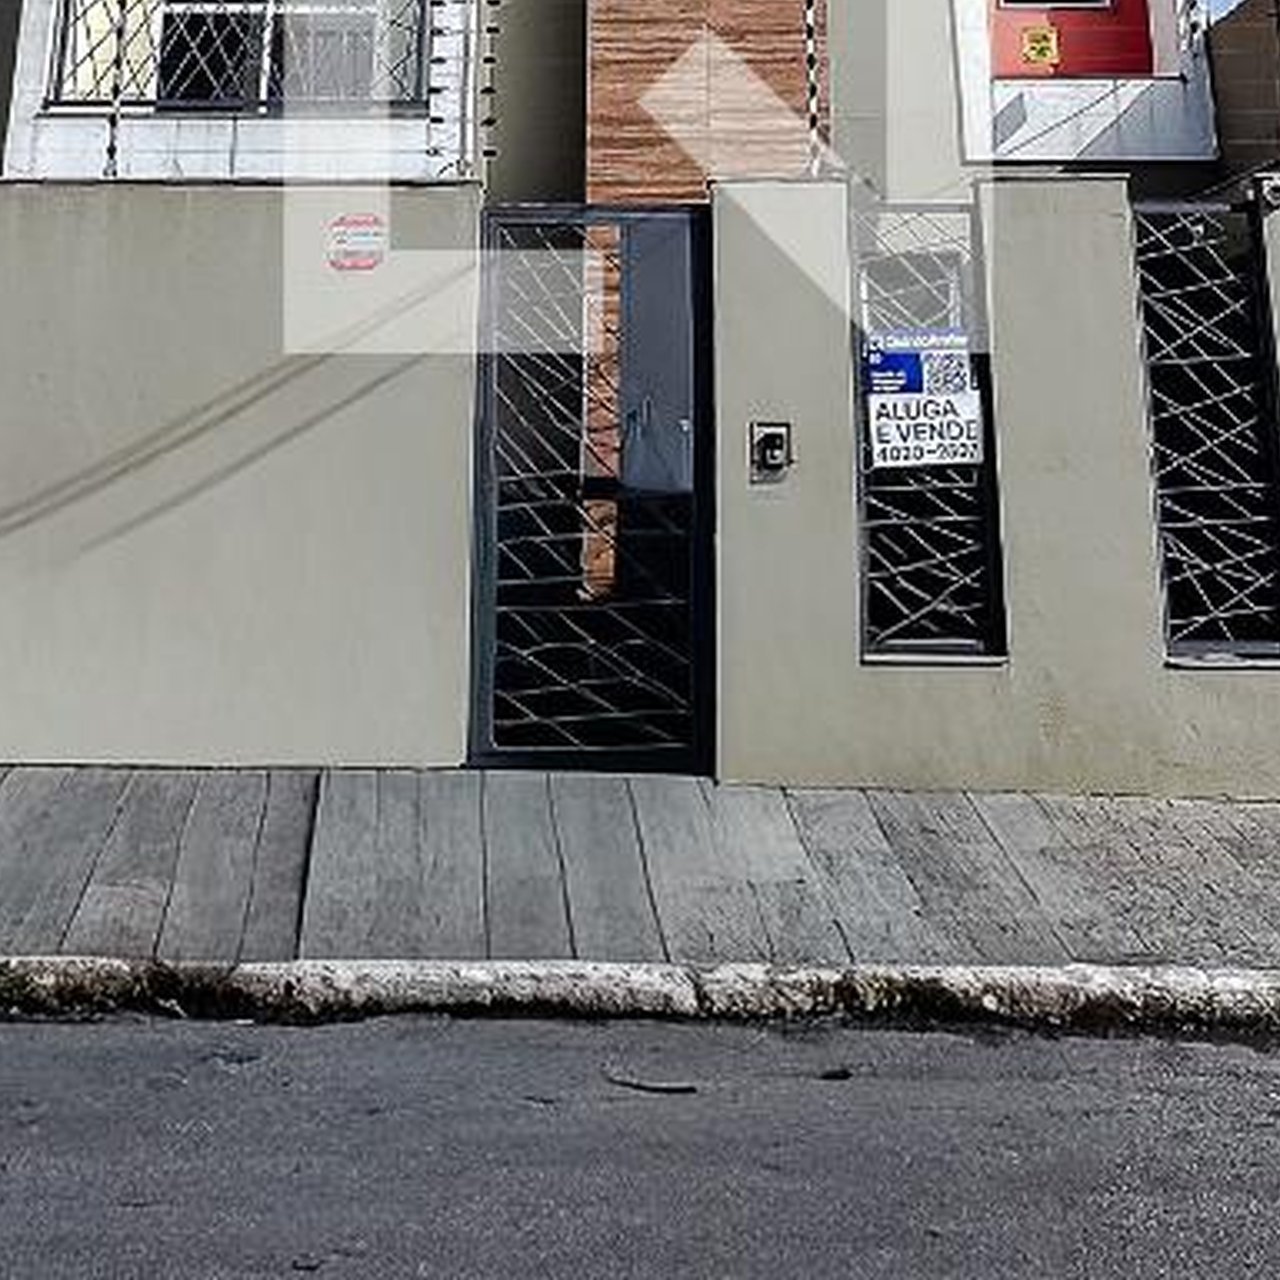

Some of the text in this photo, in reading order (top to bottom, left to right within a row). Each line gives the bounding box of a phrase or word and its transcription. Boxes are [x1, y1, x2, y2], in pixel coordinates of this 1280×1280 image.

[875, 399, 960, 422] ALUGA
[876, 420, 978, 444] E VENDE
